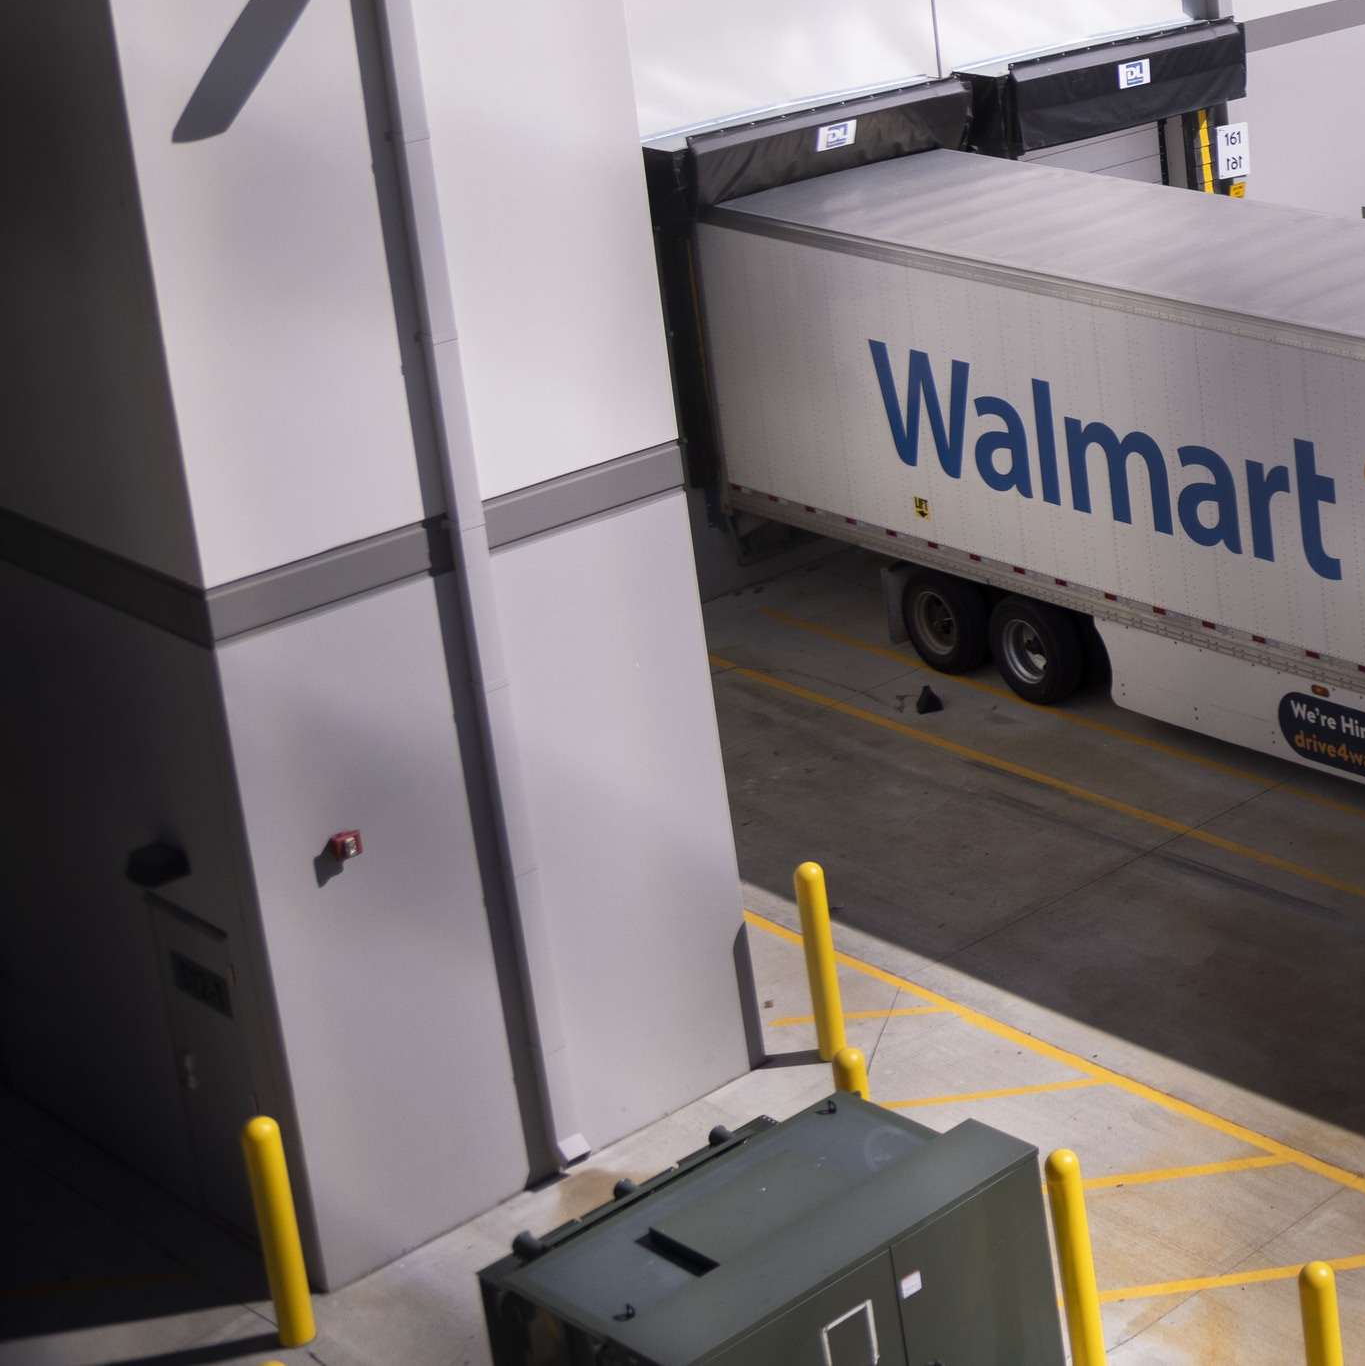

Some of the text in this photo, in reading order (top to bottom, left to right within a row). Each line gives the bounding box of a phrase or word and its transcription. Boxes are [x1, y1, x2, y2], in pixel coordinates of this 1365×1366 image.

[1225, 131, 1241, 146] 161
[868, 339, 1341, 580] Walmart
[1290, 700, 1337, 730] We're
